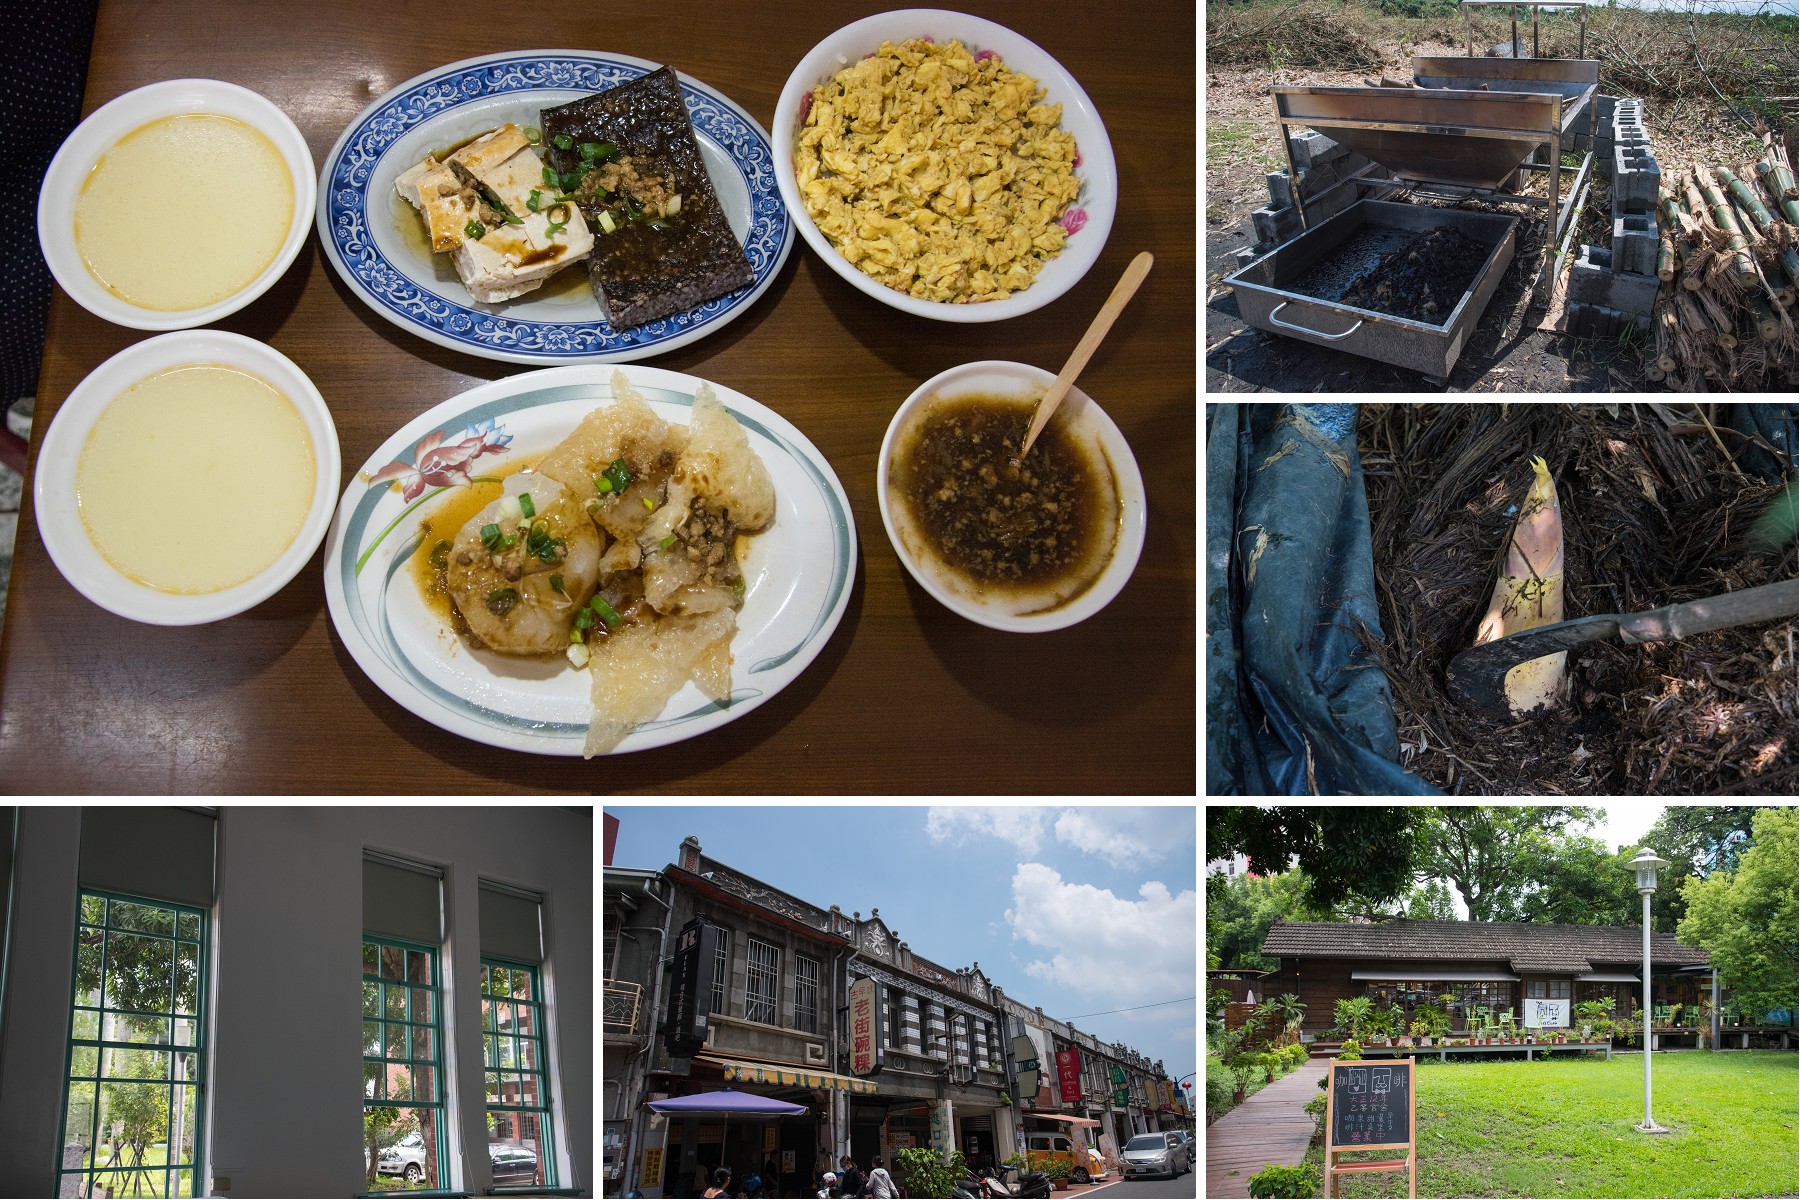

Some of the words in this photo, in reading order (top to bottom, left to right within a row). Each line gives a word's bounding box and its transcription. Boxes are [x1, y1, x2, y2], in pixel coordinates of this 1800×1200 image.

[851, 984, 873, 1000] 古早味
[854, 998, 871, 1072] 老街碗粿
